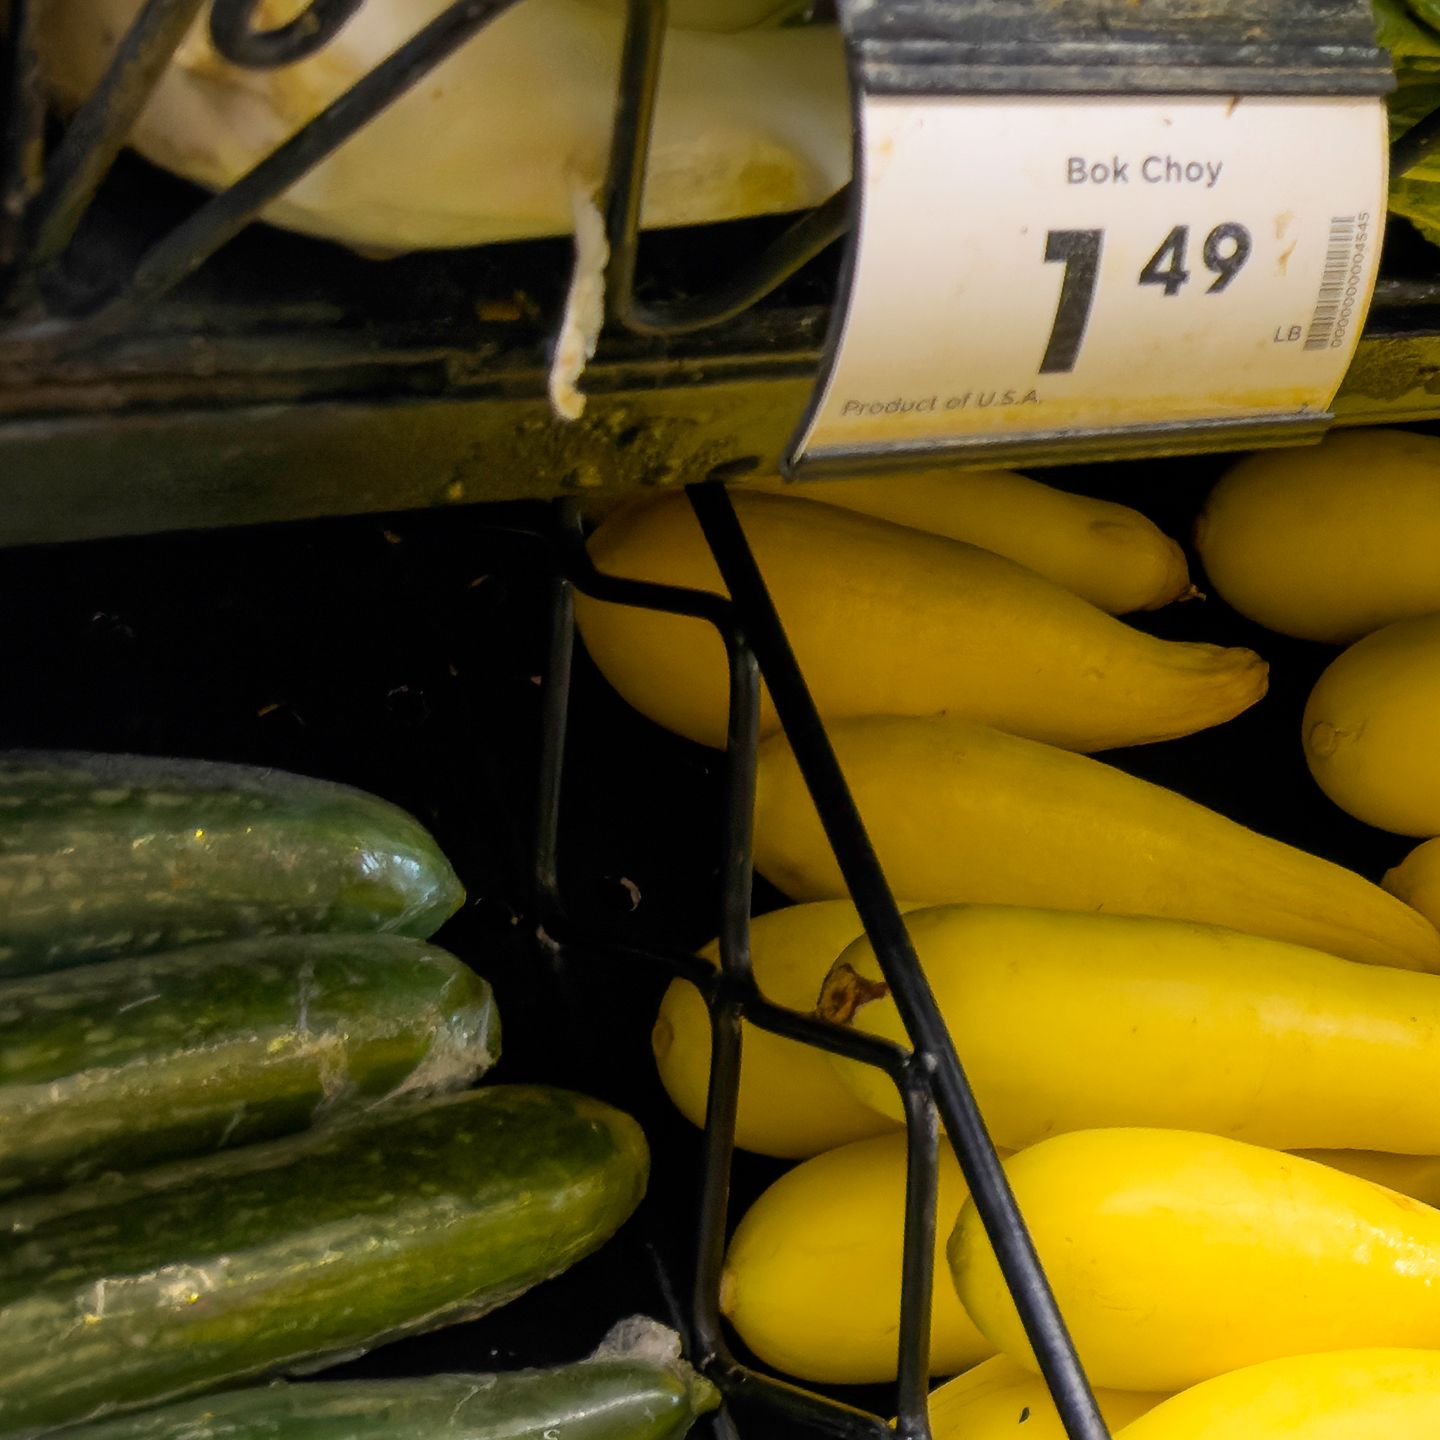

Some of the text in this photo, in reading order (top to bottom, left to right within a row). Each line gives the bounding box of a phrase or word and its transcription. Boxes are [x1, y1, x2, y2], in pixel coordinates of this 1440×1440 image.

[1066, 155, 1224, 190] Bok Choy
[1037, 221, 1253, 376] 1 49
[1273, 324, 1303, 343] LB
[841, 395, 937, 418] Product
[945, 391, 972, 411] of
